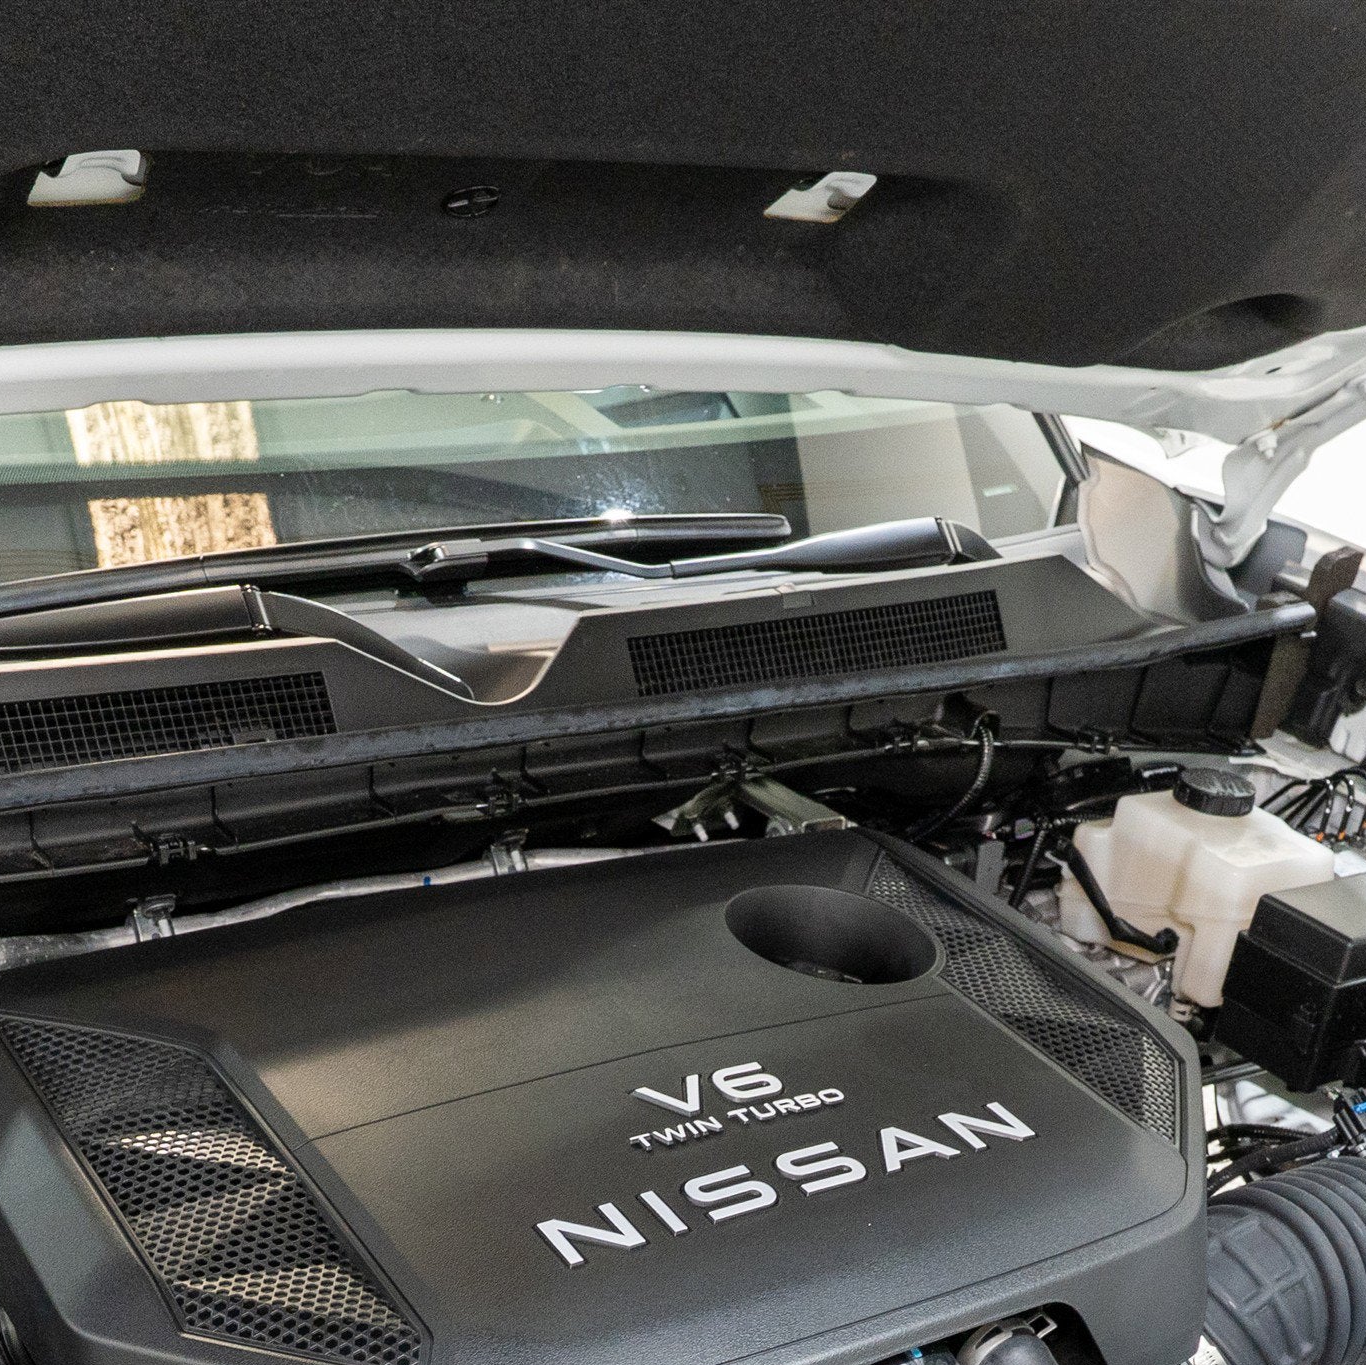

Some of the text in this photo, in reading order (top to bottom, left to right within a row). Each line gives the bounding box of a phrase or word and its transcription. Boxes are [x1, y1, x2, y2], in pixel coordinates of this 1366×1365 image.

[630, 1088, 845, 1151] TWIN TURBO
[633, 1061, 783, 1117] V6
[536, 1102, 1036, 1268] NISSAN
